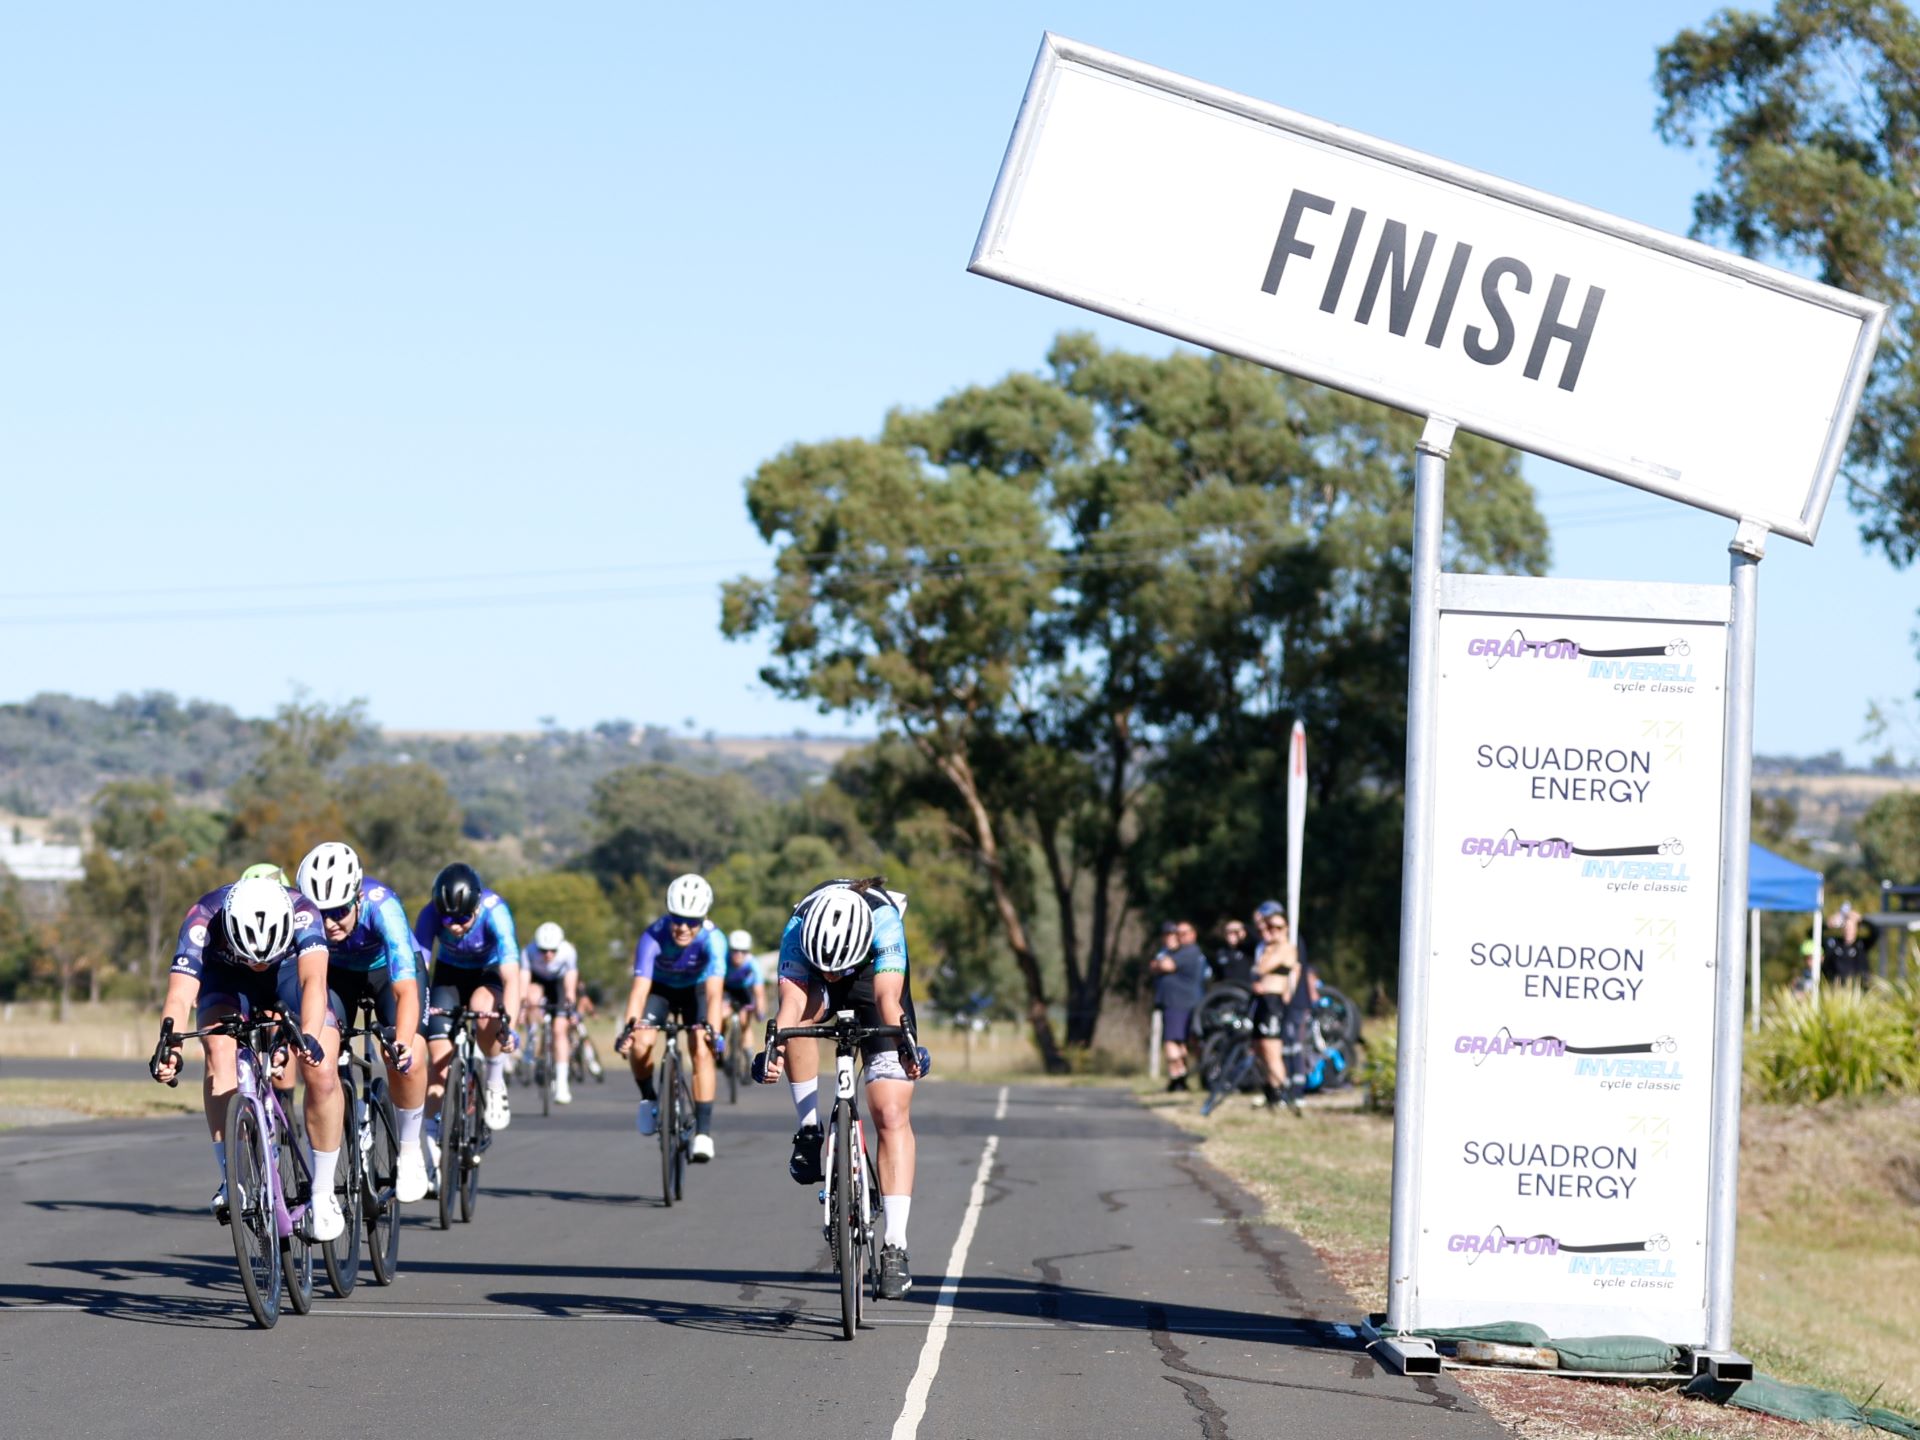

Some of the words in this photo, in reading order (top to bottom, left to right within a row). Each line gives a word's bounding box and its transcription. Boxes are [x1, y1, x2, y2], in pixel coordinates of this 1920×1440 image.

[1261, 189, 1605, 393] FINISH
[1467, 638, 1580, 660] GRAFTON
[1588, 660, 1696, 682] INVERELL
[1613, 682, 1646, 694] cycle
[1650, 682, 1695, 694] classic
[1476, 744, 1650, 775] SQUADRON
[1531, 776, 1651, 803] ENERGY
[1461, 836, 1574, 859] GRAFTON
[1581, 859, 1690, 881] INVERELL
[1606, 881, 1639, 893] cycle
[1643, 881, 1688, 893] classic
[1470, 942, 1644, 973] SQUADRON
[1524, 974, 1644, 1002] ENERGY
[1454, 1035, 1567, 1057] GRAFTON
[1574, 1058, 1683, 1080] INVERELL
[1600, 1080, 1633, 1091] cycle
[1637, 1080, 1682, 1092] classic
[1463, 1140, 1637, 1171] SQUADRON
[1517, 1172, 1637, 1200] ENERGY
[1447, 1234, 1560, 1256] GRAFTON
[1568, 1256, 1676, 1278] INVERELL
[1593, 1278, 1626, 1290] cycle
[1631, 1279, 1675, 1290] classic
